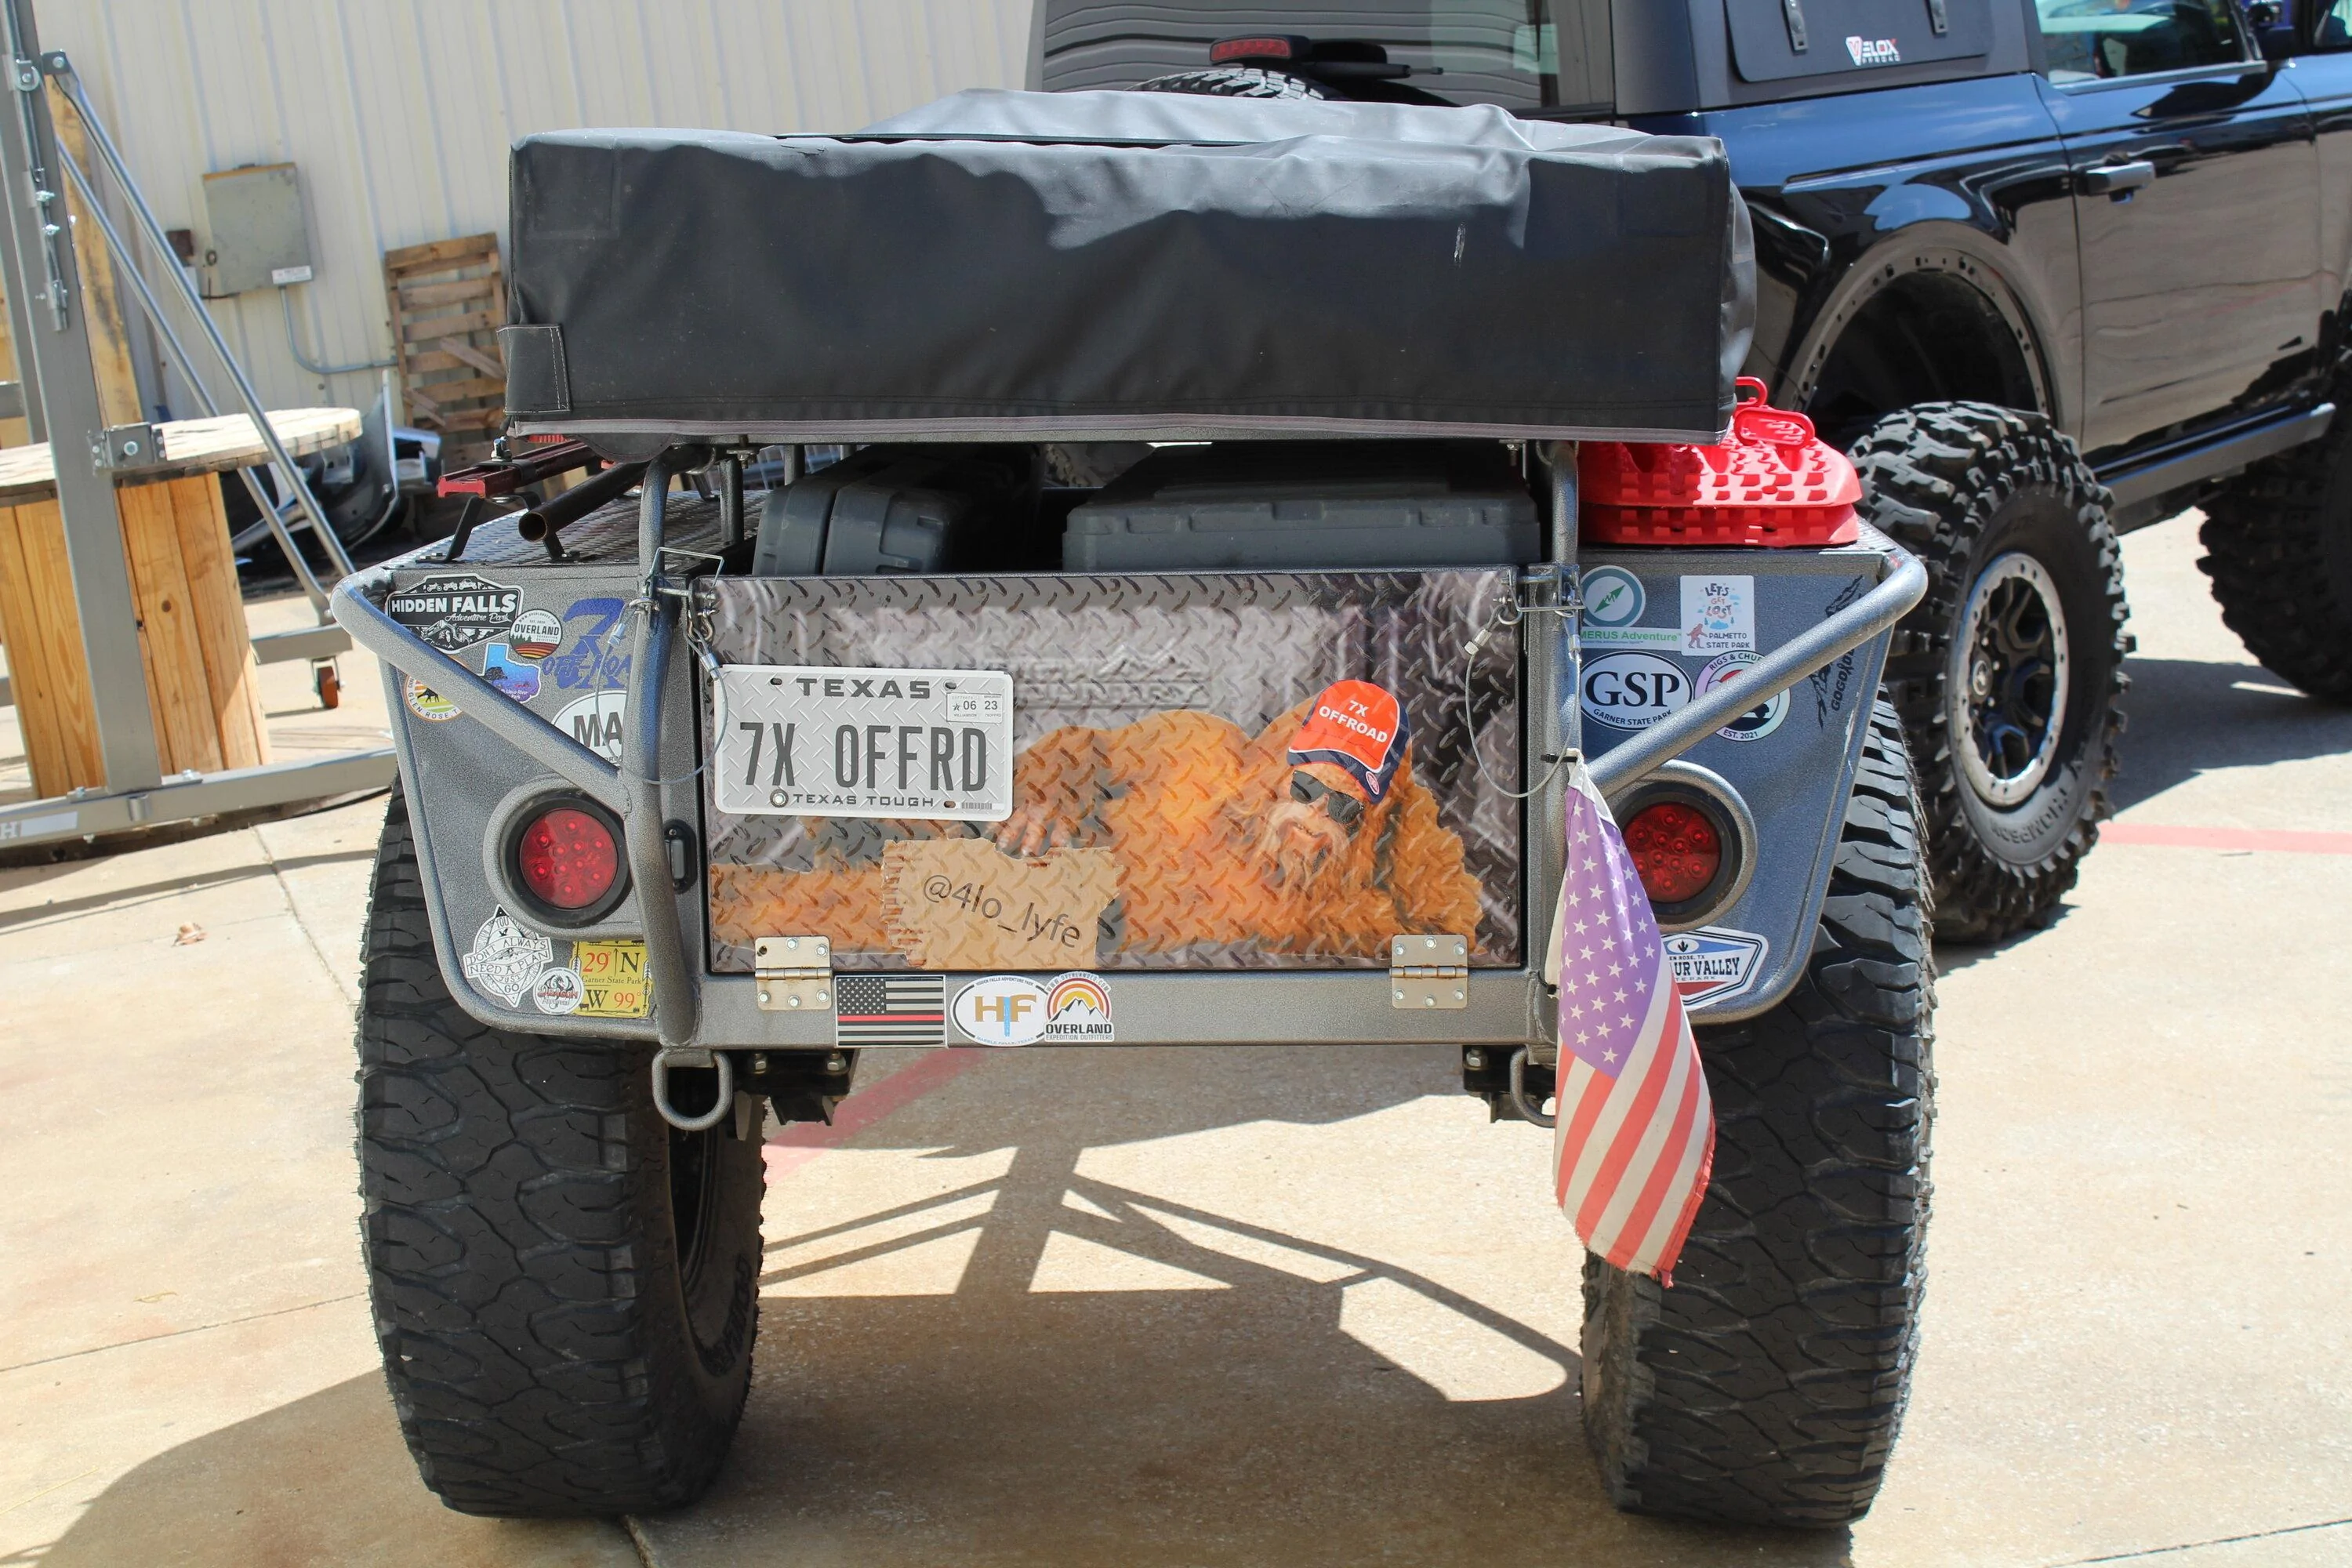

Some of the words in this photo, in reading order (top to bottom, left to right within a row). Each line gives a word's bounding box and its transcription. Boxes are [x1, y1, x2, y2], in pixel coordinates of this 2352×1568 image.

[1846, 36, 1899, 66] VELOX
[391, 597, 448, 614] HIDDEN
[452, 593, 518, 613] FALLS
[1706, 604, 1732, 619] LOST
[445, 613, 487, 622] Adventure
[488, 613, 512, 623] Park
[514, 623, 560, 636] OVERLAND
[1709, 657, 1727, 670] RIGS
[796, 678, 931, 699] TEXAS
[1584, 670, 1680, 707] GSP
[408, 691, 423, 712] GLEN
[963, 700, 977, 710] 06
[984, 700, 998, 710] 23
[1348, 699, 1370, 717] 7X
[1319, 706, 1388, 743] OFFROAD
[1593, 709, 1625, 724] GARNER
[1653, 710, 1672, 722] PARK
[1723, 729, 1738, 739] EST.
[740, 722, 796, 786] 7X
[835, 724, 987, 792] OFFRD
[793, 793, 857, 805] TEXAS
[866, 795, 935, 808] TOUGH
[496, 915, 510, 927] YOU
[503, 937, 546, 949] ALWAYS
[506, 965, 514, 975] A
[517, 950, 548, 970] PLAN
[619, 952, 640, 973] N
[1693, 957, 1740, 975] VALLEY
[499, 974, 521, 983] JUST
[504, 983, 520, 993] GO
[586, 989, 608, 1008] W
[974, 994, 1037, 1022] HF
[1046, 1023, 1112, 1034] OVERLAND
